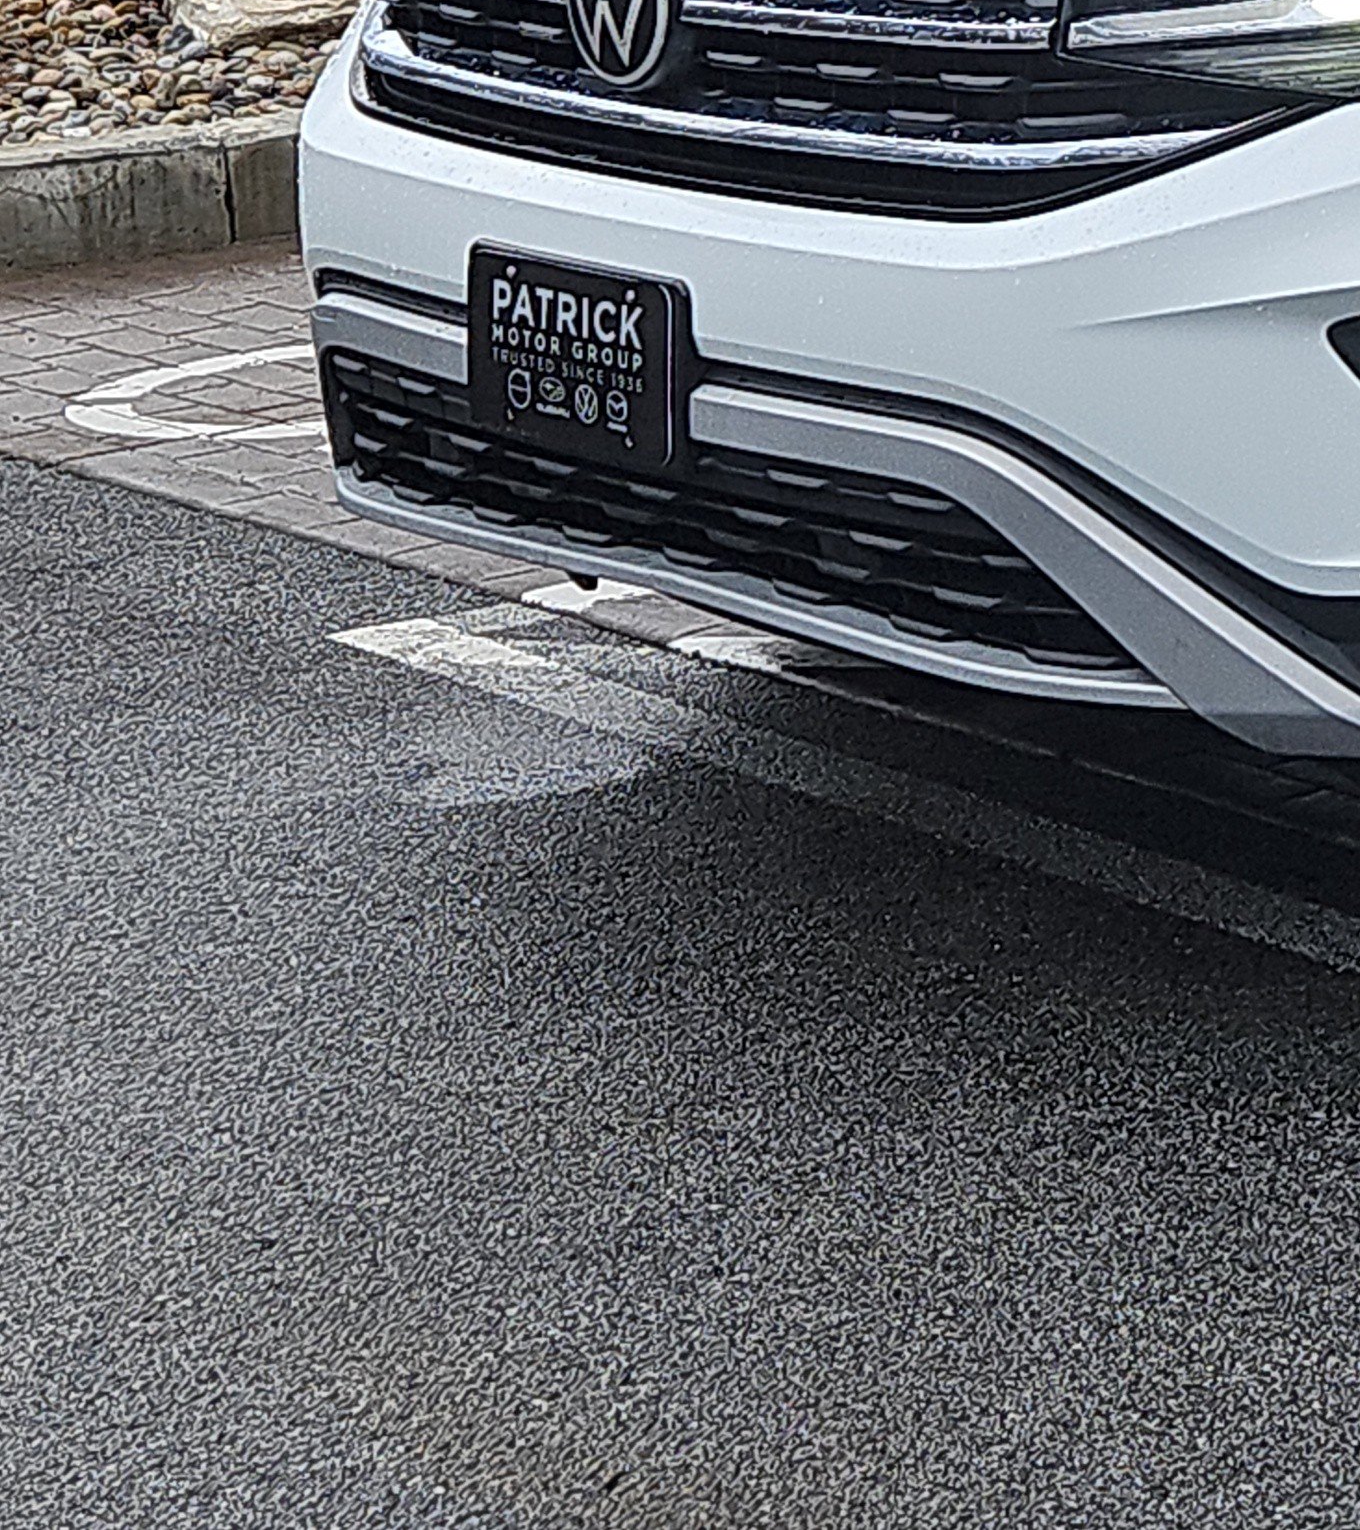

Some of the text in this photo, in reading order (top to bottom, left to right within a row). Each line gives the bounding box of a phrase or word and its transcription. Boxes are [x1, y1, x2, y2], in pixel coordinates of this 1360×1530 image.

[491, 278, 643, 350] PATRICK
[491, 322, 643, 373] MOTOR GROUP
[491, 346, 556, 374] TRUSTED
[562, 361, 604, 386] SINCE
